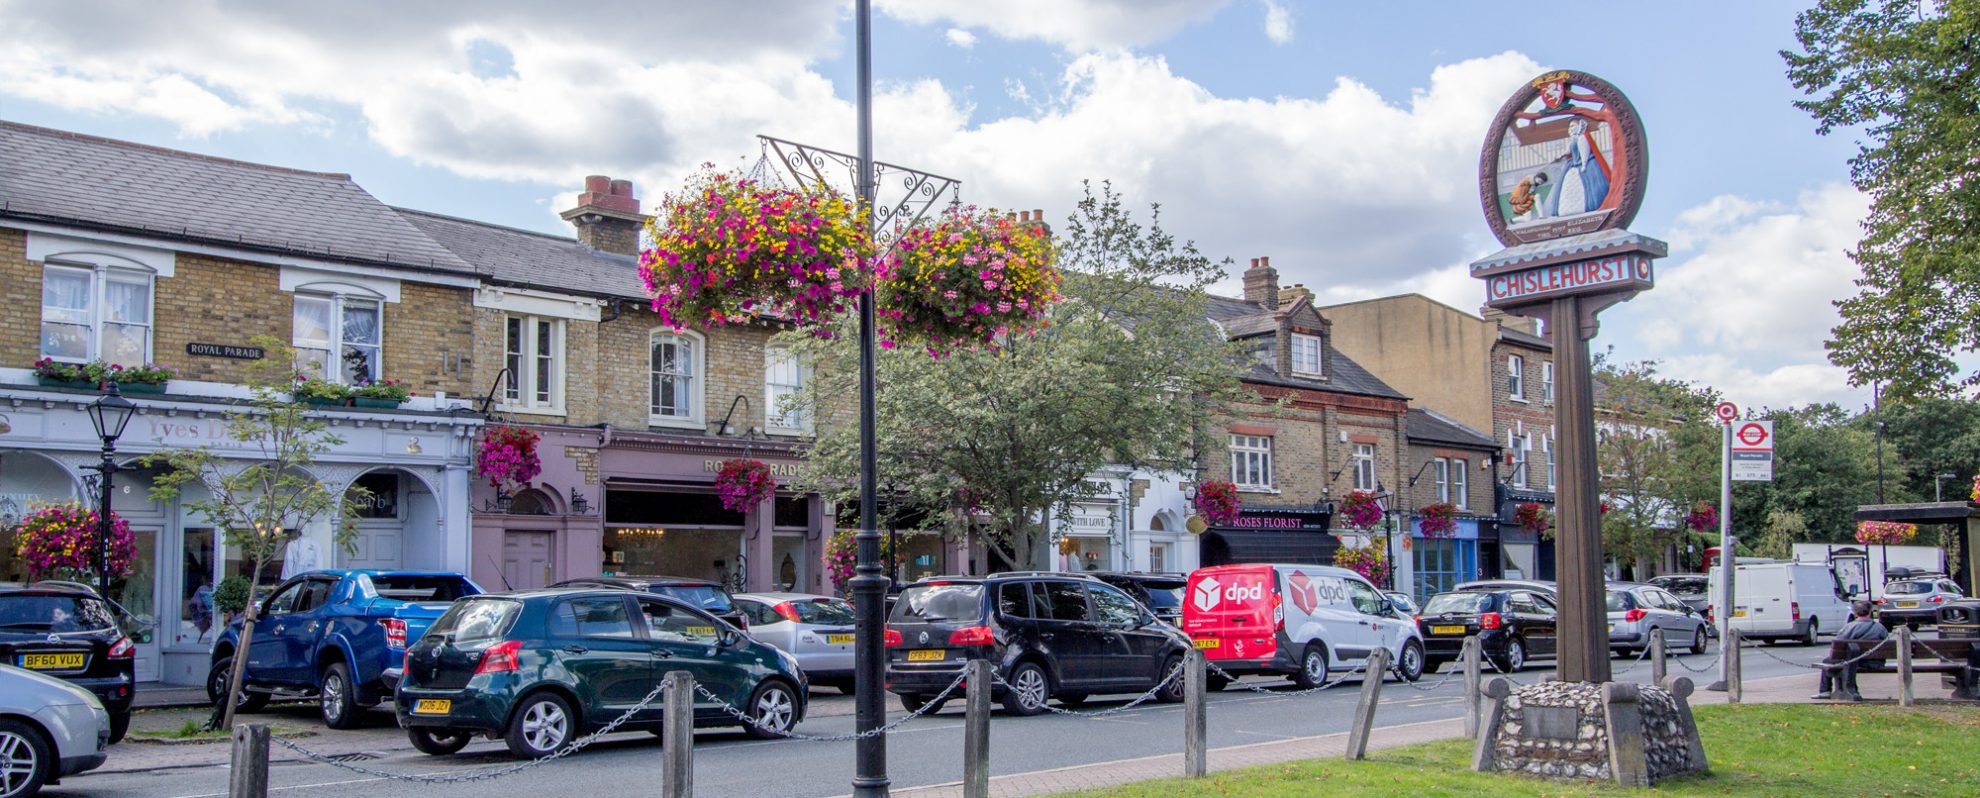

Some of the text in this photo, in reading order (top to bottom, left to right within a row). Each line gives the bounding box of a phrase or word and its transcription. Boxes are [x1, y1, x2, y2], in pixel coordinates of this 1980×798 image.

[1567, 216, 1604, 227] ELIZABETH
[1492, 257, 1626, 299] CHISLEHURST
[191, 344, 260, 358] ROYAL PARADE
[147, 415, 199, 439] Yves
[769, 464, 804, 477] RADE
[123, 485, 131, 494] 6
[1089, 518, 1106, 528] LOVE
[1233, 517, 1262, 528] ROSES
[1264, 518, 1302, 529] FLORIST
[1478, 568, 1483, 576] 3
[1225, 581, 1262, 605] dpd
[1319, 580, 1345, 605] dpd
[27, 654, 81, 666] BF60 VUX
